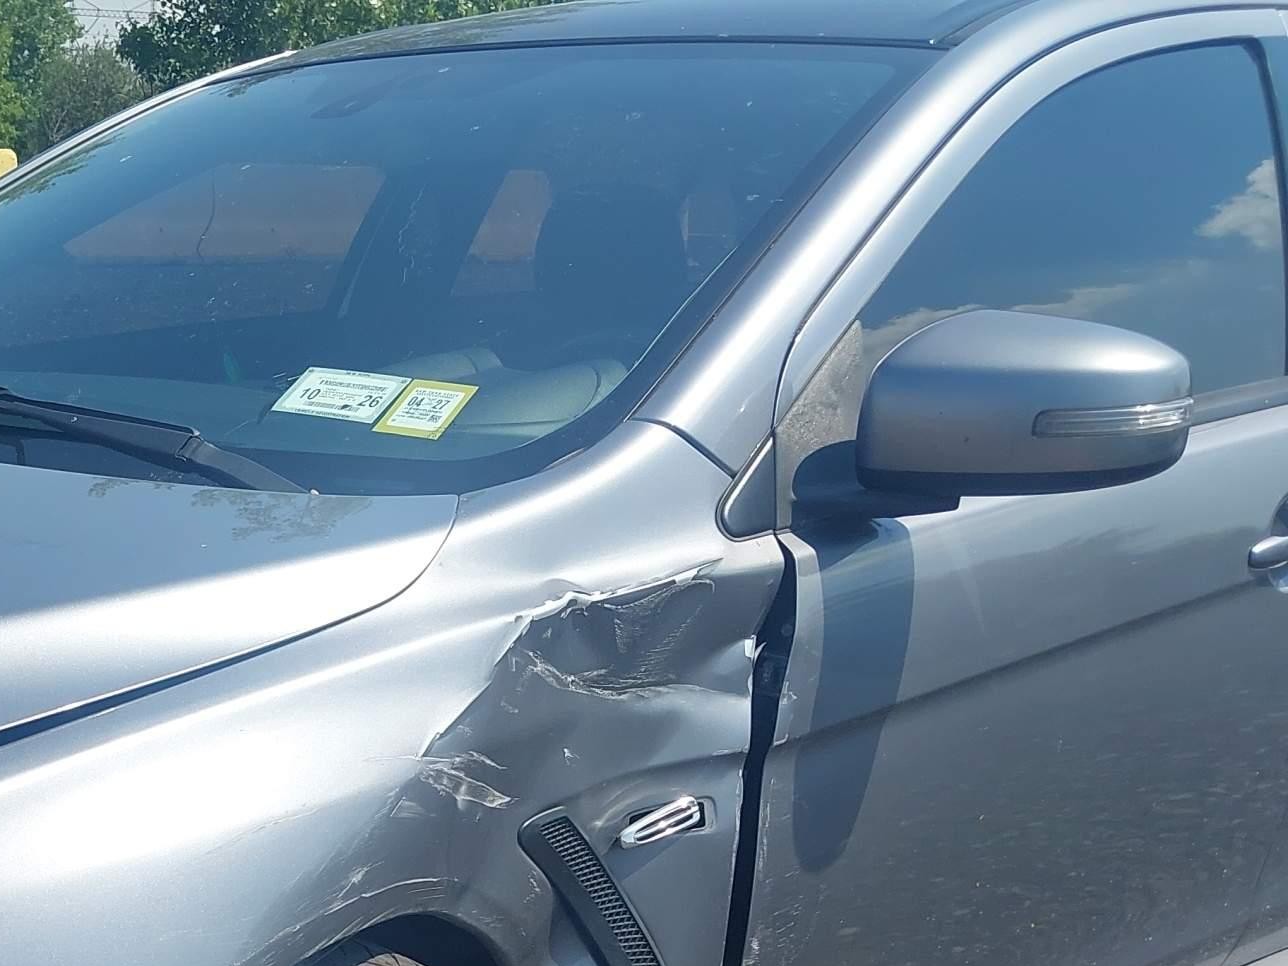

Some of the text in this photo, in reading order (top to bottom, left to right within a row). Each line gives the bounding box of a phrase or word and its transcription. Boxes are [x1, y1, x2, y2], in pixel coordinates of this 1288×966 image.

[299, 387, 321, 401] 10
[356, 394, 384, 408] 26
[407, 396, 425, 408] 04
[431, 399, 451, 410] 27
